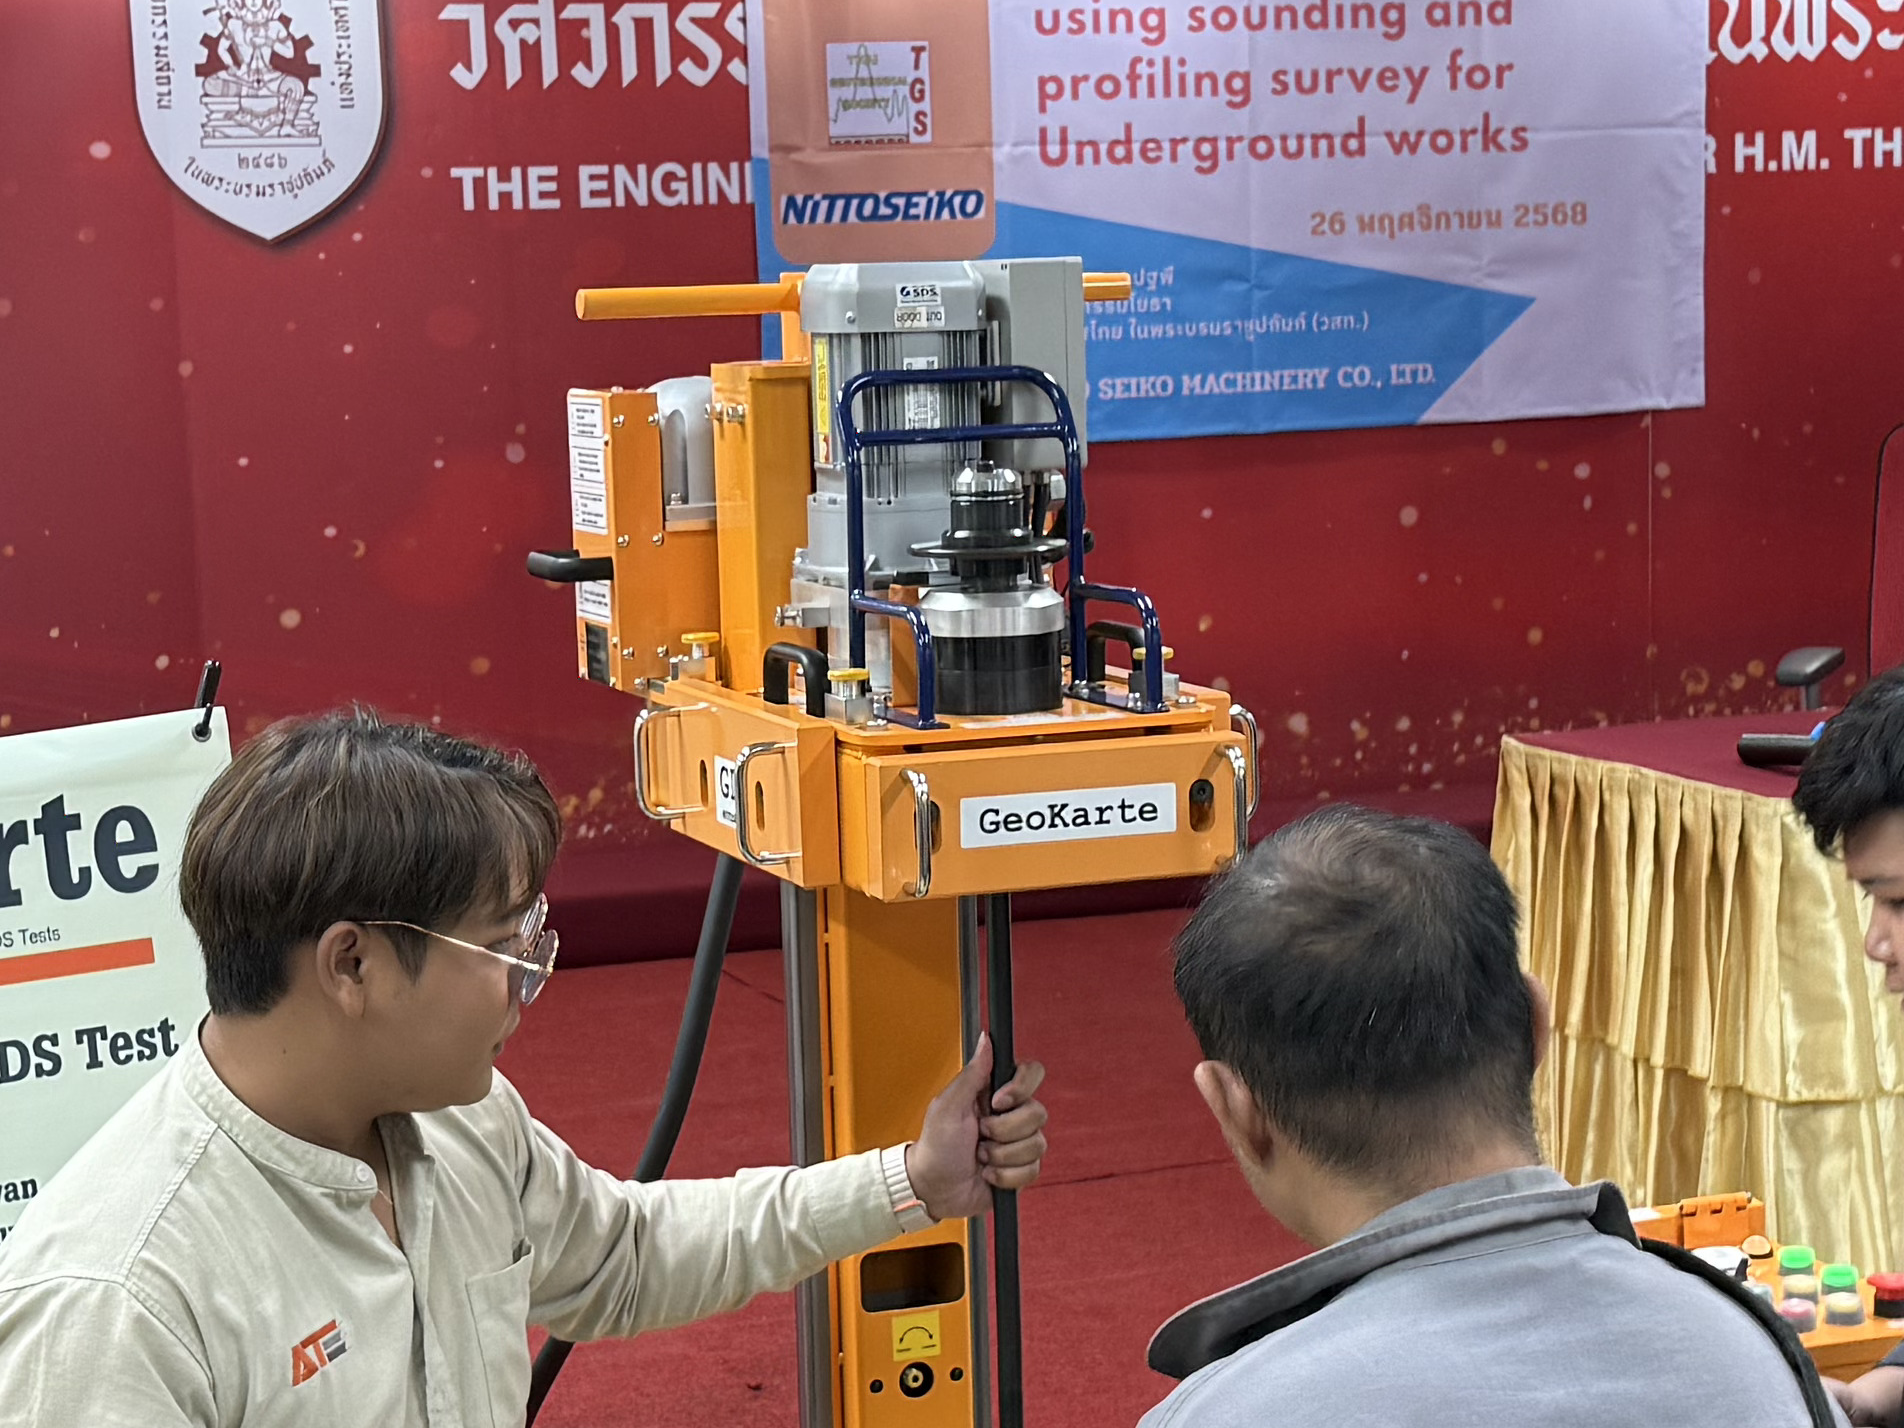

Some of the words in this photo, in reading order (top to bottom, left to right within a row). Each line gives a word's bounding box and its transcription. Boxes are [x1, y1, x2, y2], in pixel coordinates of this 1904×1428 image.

[1036, 61, 1253, 116] profiling
[1269, 57, 1430, 107] survey
[1446, 52, 1515, 92] for
[1036, 118, 1367, 176] Underground
[1383, 115, 1530, 157] works
[1734, 129, 1831, 173] H.M.
[451, 167, 561, 211] THE
[579, 161, 754, 210] ENGIN
[1309, 209, 1347, 237] 26
[1355, 197, 1504, 240] พฤศจิกายน
[1513, 199, 1589, 229] 2568
[1098, 375, 1174, 400] SEIKO
[1181, 368, 1330, 397] MACHINERY
[1337, 366, 1383, 390] CO.,
[1389, 363, 1437, 386] LTD.
[979, 798, 1159, 835] GeoKarte
[18, 926, 59, 945] Tests
[75, 1017, 180, 1070] Test
